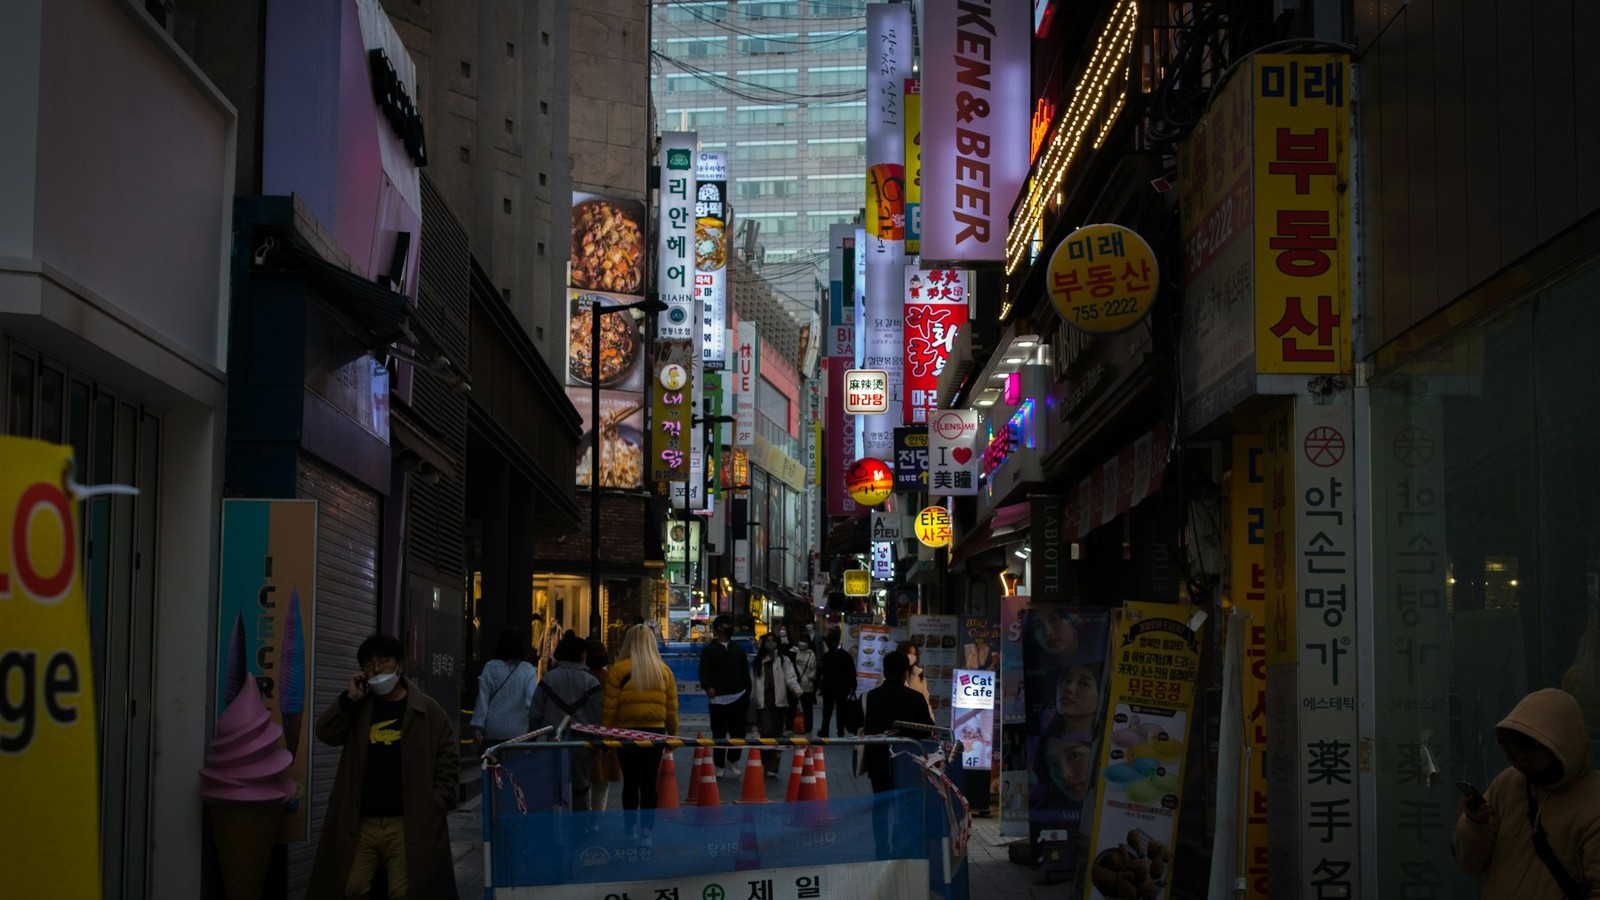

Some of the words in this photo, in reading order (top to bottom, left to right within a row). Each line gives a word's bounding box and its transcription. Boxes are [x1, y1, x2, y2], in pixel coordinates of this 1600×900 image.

[1261, 62, 1343, 107] 미래
[666, 178, 690, 288] 리안헤어
[1068, 231, 1125, 262] 미래
[1269, 127, 1341, 362] 부동산
[1052, 258, 1151, 302] 부동산
[662, 294, 692, 302] RIAHN
[1072, 296, 1138, 322] 755-2222
[875, 318, 902, 328] 닭갈비
[849, 379, 884, 391] 麻辣烫
[849, 393, 884, 406] 마라탕
[939, 421, 962, 431] LENS
[739, 432, 751, 441] 2F
[938, 446, 948, 466] I
[934, 470, 972, 489] 美瞳
[921, 512, 949, 526] 타로
[874, 528, 899, 538] PIEU
[922, 527, 951, 541] 사주
[1044, 505, 1059, 594] LABIOTTE
[877, 547, 889, 572] 냉면
[1304, 477, 1347, 685] 약손명가
[966, 617, 988, 629] BBQ
[971, 675, 992, 686] Cat
[964, 686, 992, 697] Cafe
[1128, 678, 1181, 701] 무료증정
[1302, 696, 1356, 712] 에스테틱
[966, 757, 979, 767] 4F
